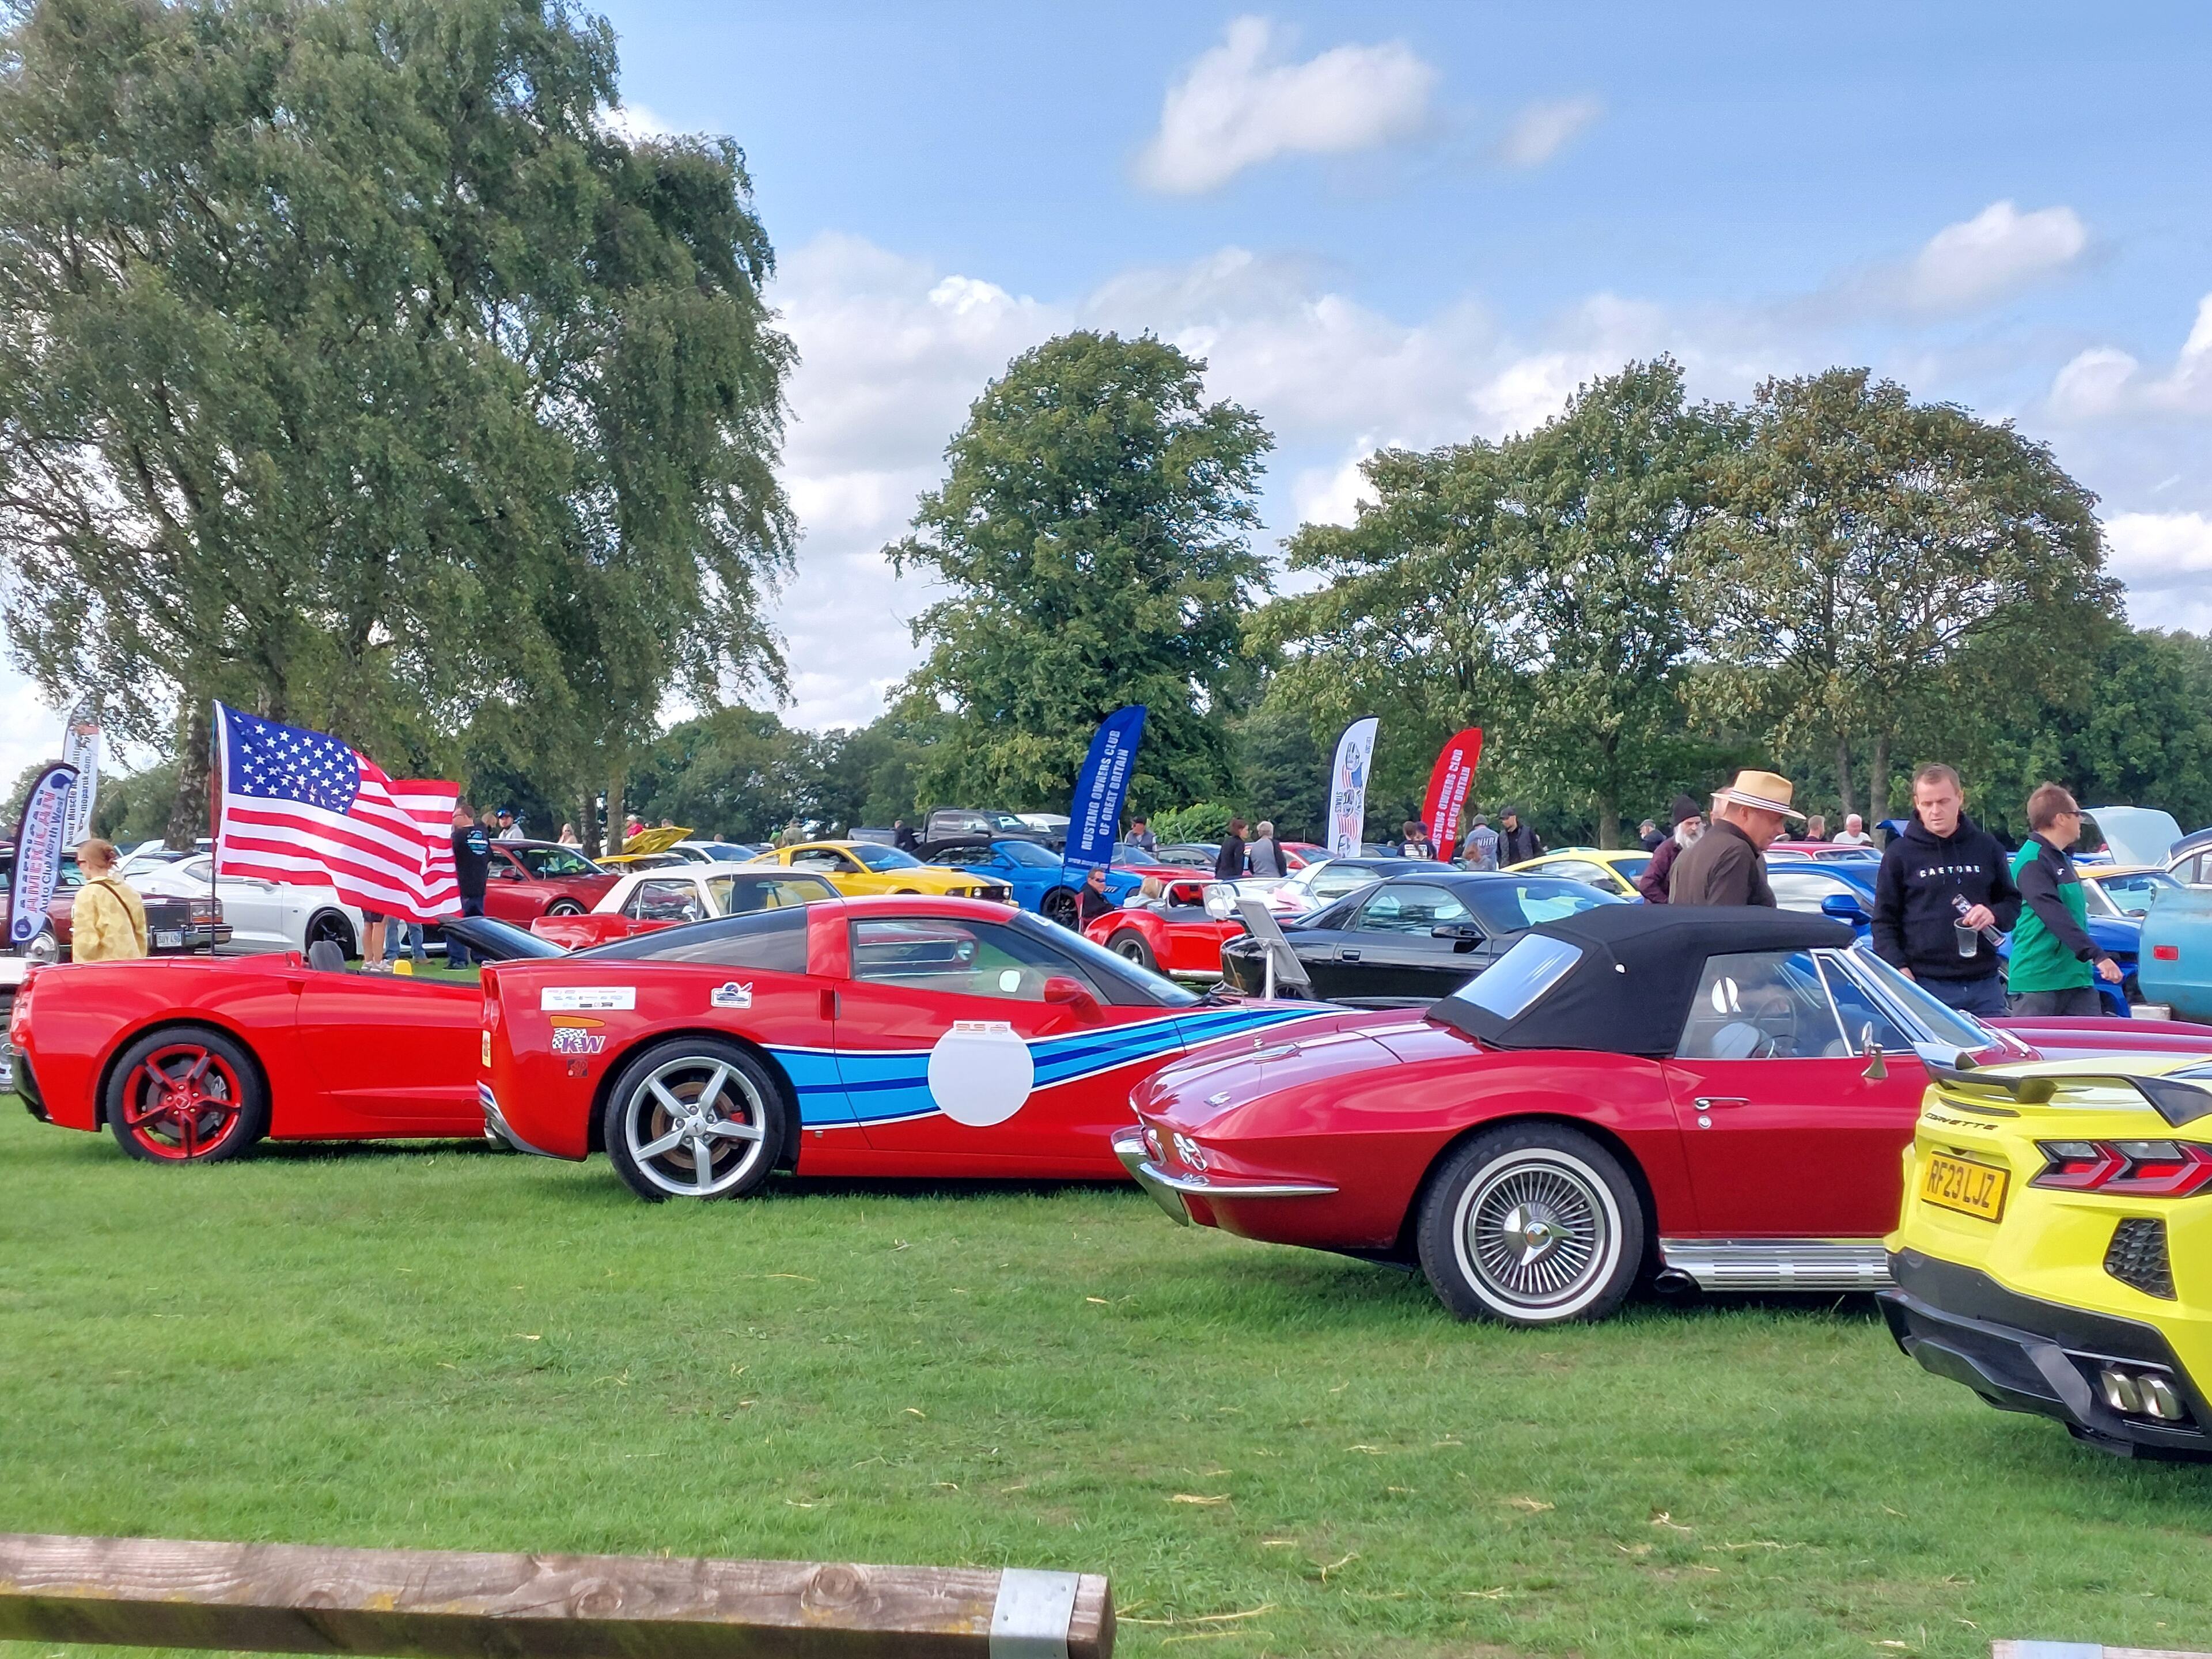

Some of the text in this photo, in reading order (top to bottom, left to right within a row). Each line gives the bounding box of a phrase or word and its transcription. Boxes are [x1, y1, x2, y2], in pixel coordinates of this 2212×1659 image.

[1081, 801, 1100, 850] MUSTANG
[1091, 757, 1111, 800] OWNERS
[1104, 730, 1121, 756] CLUB
[1099, 748, 1129, 835] OF GREAT BRITAIN
[1432, 749, 1463, 854] USTANG OWNERS CLUB
[1445, 766, 1471, 840] OF GREAT BRITAIN
[20, 790, 56, 914] AMERICAN
[39, 796, 65, 913] Auto Club North West
[560, 1035, 607, 1054] KW
[1925, 1112, 1998, 1130] CORVETTE
[1927, 1159, 1996, 1209] RF23 LJZ
